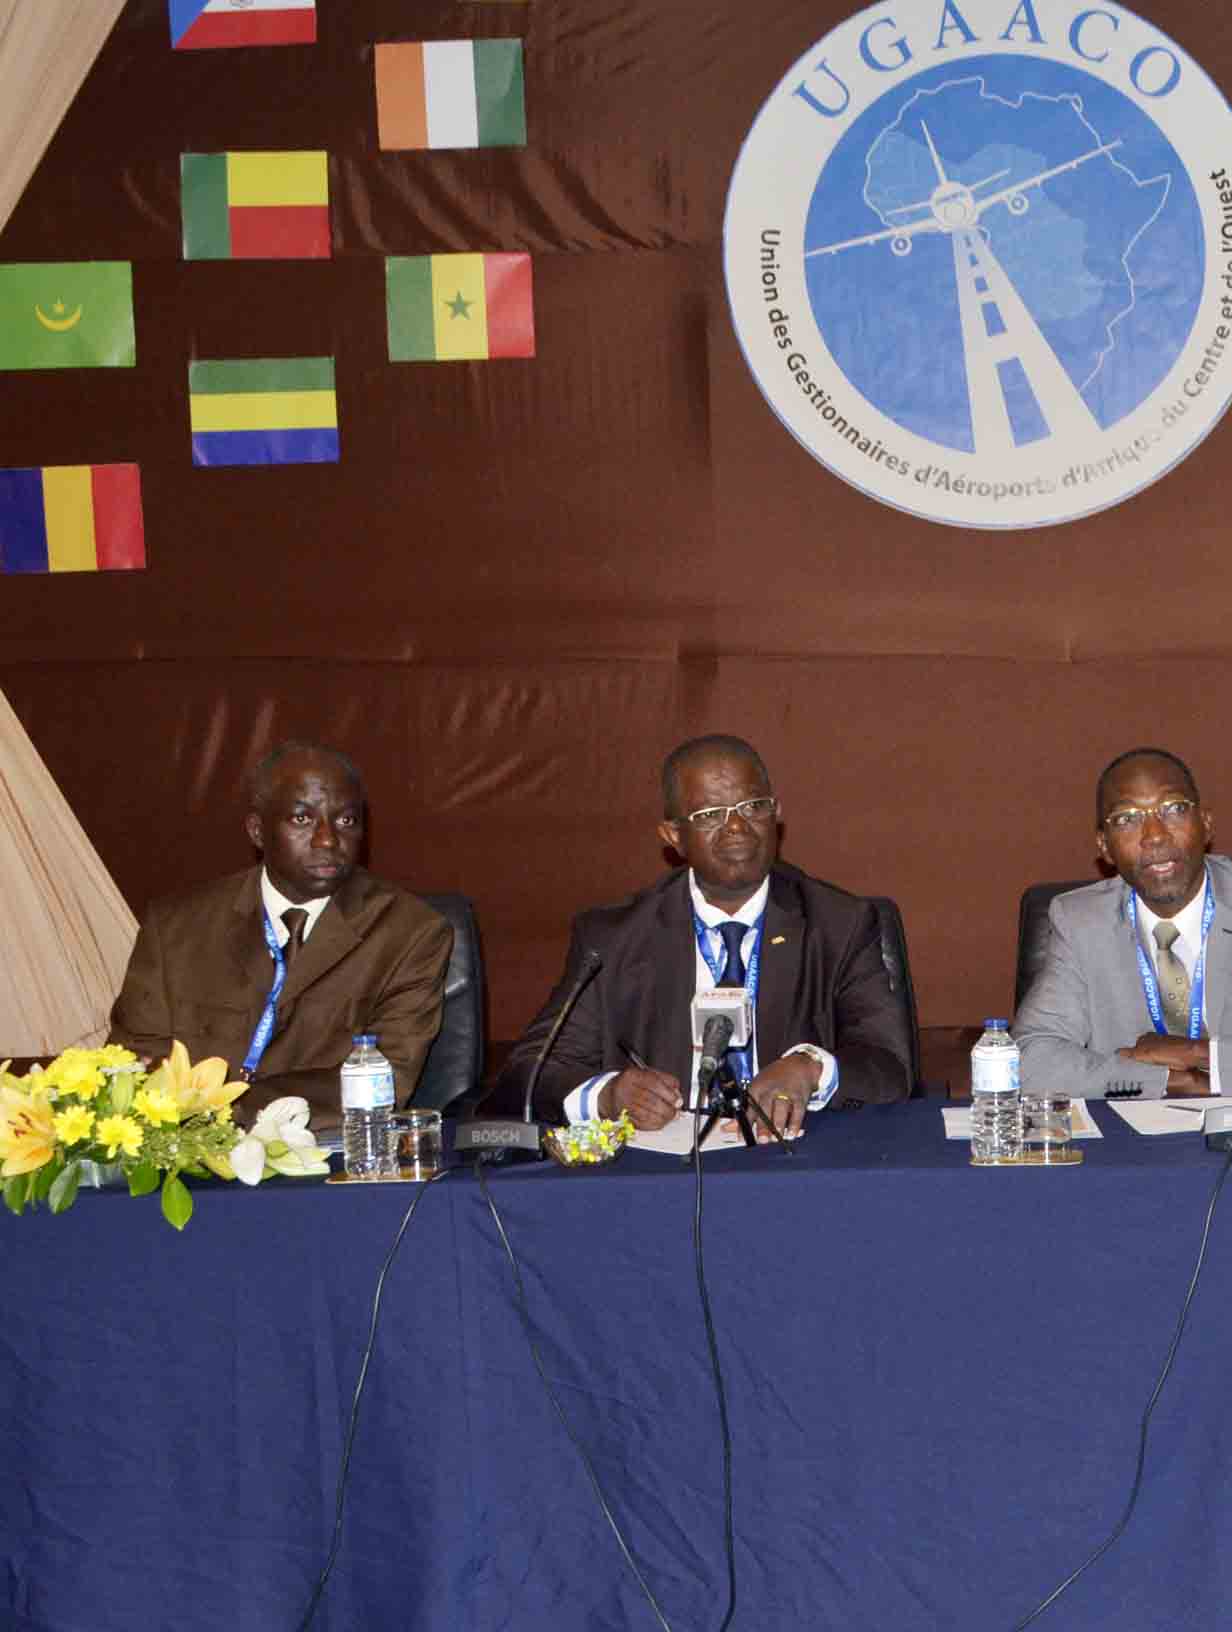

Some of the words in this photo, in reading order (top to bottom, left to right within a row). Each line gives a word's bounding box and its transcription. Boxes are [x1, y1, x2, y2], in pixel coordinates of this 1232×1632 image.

[794, 0, 1182, 117] UGAACO
[760, 229, 781, 302] Union
[768, 308, 792, 349] des
[1183, 325, 1230, 398] Centre
[786, 353, 910, 476] Gestionnaires
[1162, 400, 1187, 427] du
[1062, 434, 1161, 487] d'Afriqu
[471, 1127, 521, 1143] BOSCH
